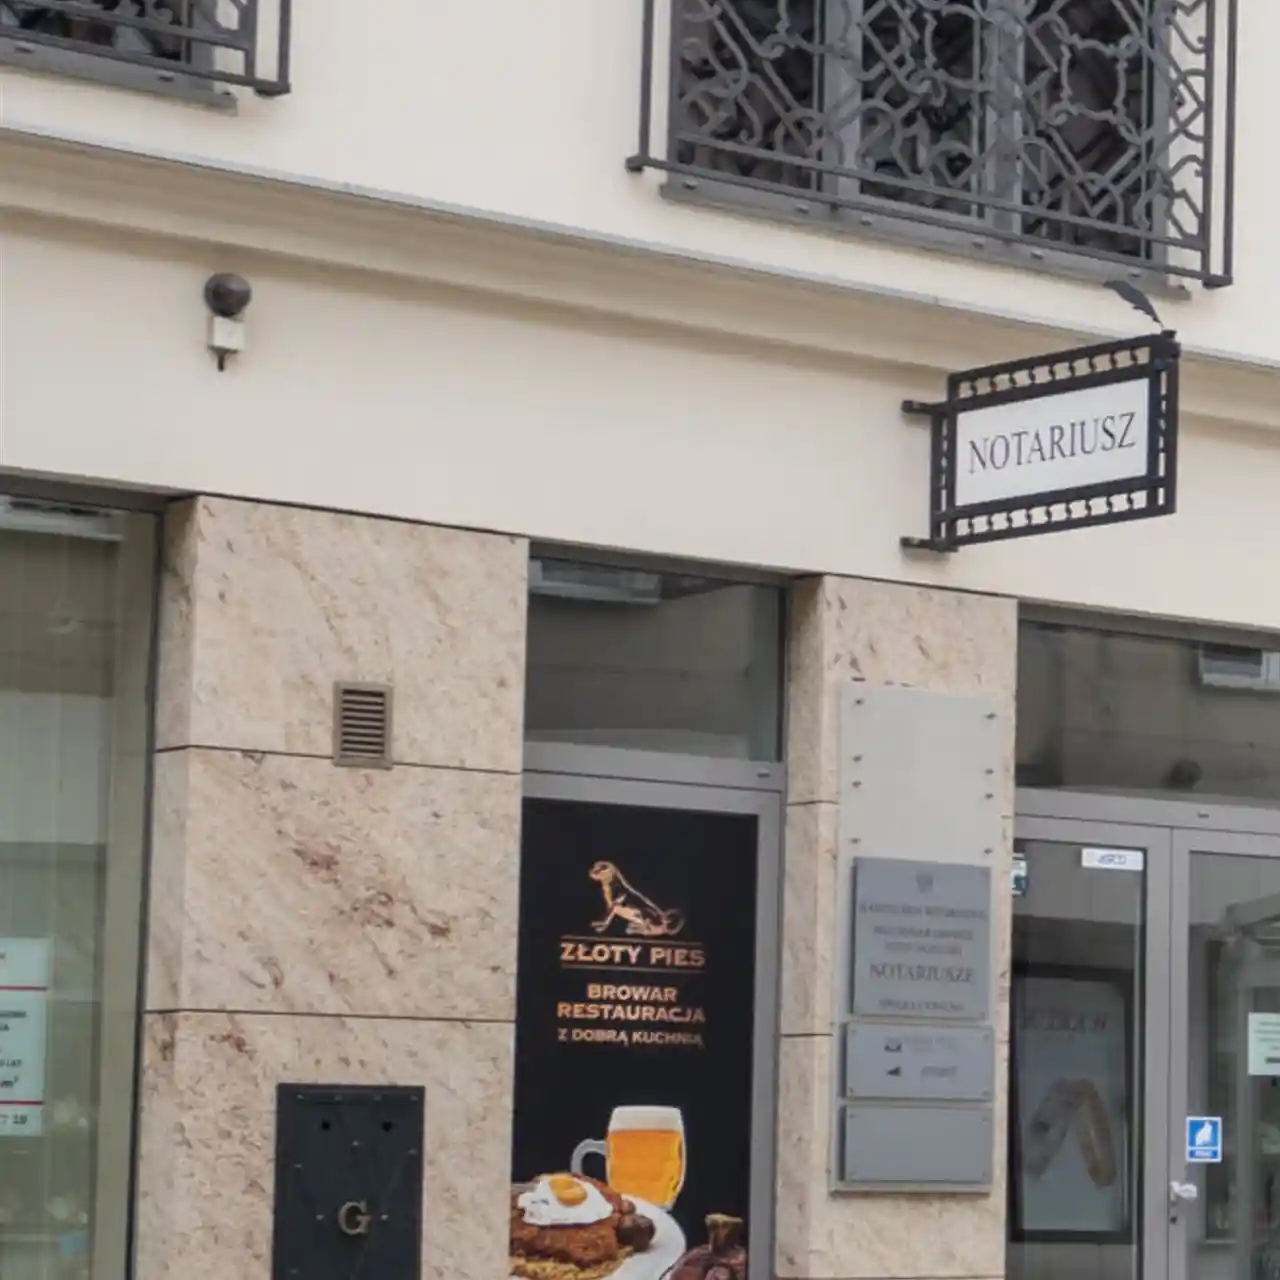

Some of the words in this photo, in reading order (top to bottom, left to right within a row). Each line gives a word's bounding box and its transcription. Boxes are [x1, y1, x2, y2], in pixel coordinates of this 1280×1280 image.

[967, 411, 1137, 475] NOTARIUSZ
[559, 942, 642, 965] ZŁOTY
[650, 946, 706, 967] PIES
[586, 982, 678, 1002] BROWAR
[556, 1001, 706, 1023] RESTAURACJA
[557, 1028, 568, 1041] Z
[571, 1028, 629, 1048] DOBRĄ
[338, 1199, 371, 1234] G
